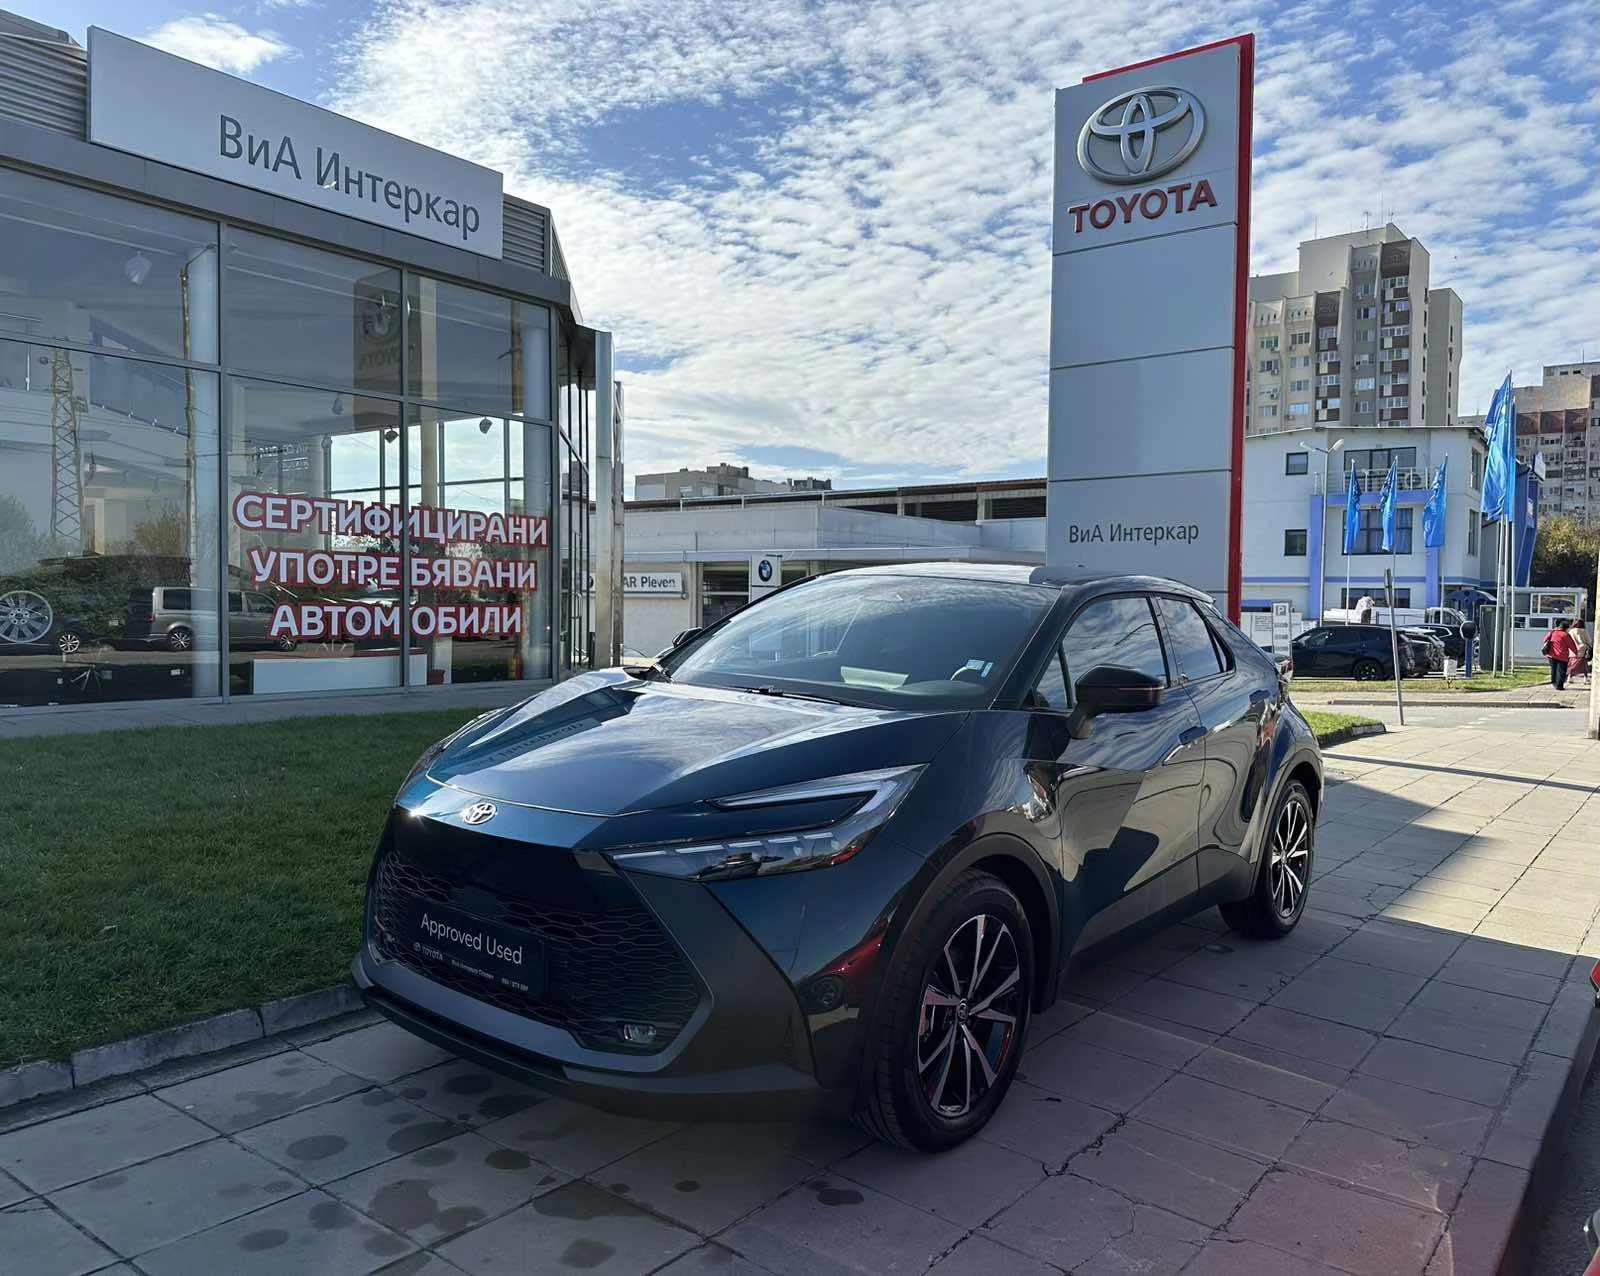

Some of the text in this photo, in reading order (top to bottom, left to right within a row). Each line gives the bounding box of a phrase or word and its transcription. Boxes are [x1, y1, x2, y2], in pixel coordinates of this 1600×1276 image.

[219, 114, 481, 241] ВиА Интеркар
[1067, 179, 1218, 233] TOYOTA
[235, 493, 548, 546] СЕРТИФИЦИРАНИ
[1069, 522, 1199, 546] ВиА Интеркар
[623, 575, 676, 588] AR Pleven
[420, 912, 523, 965] Approved Used
